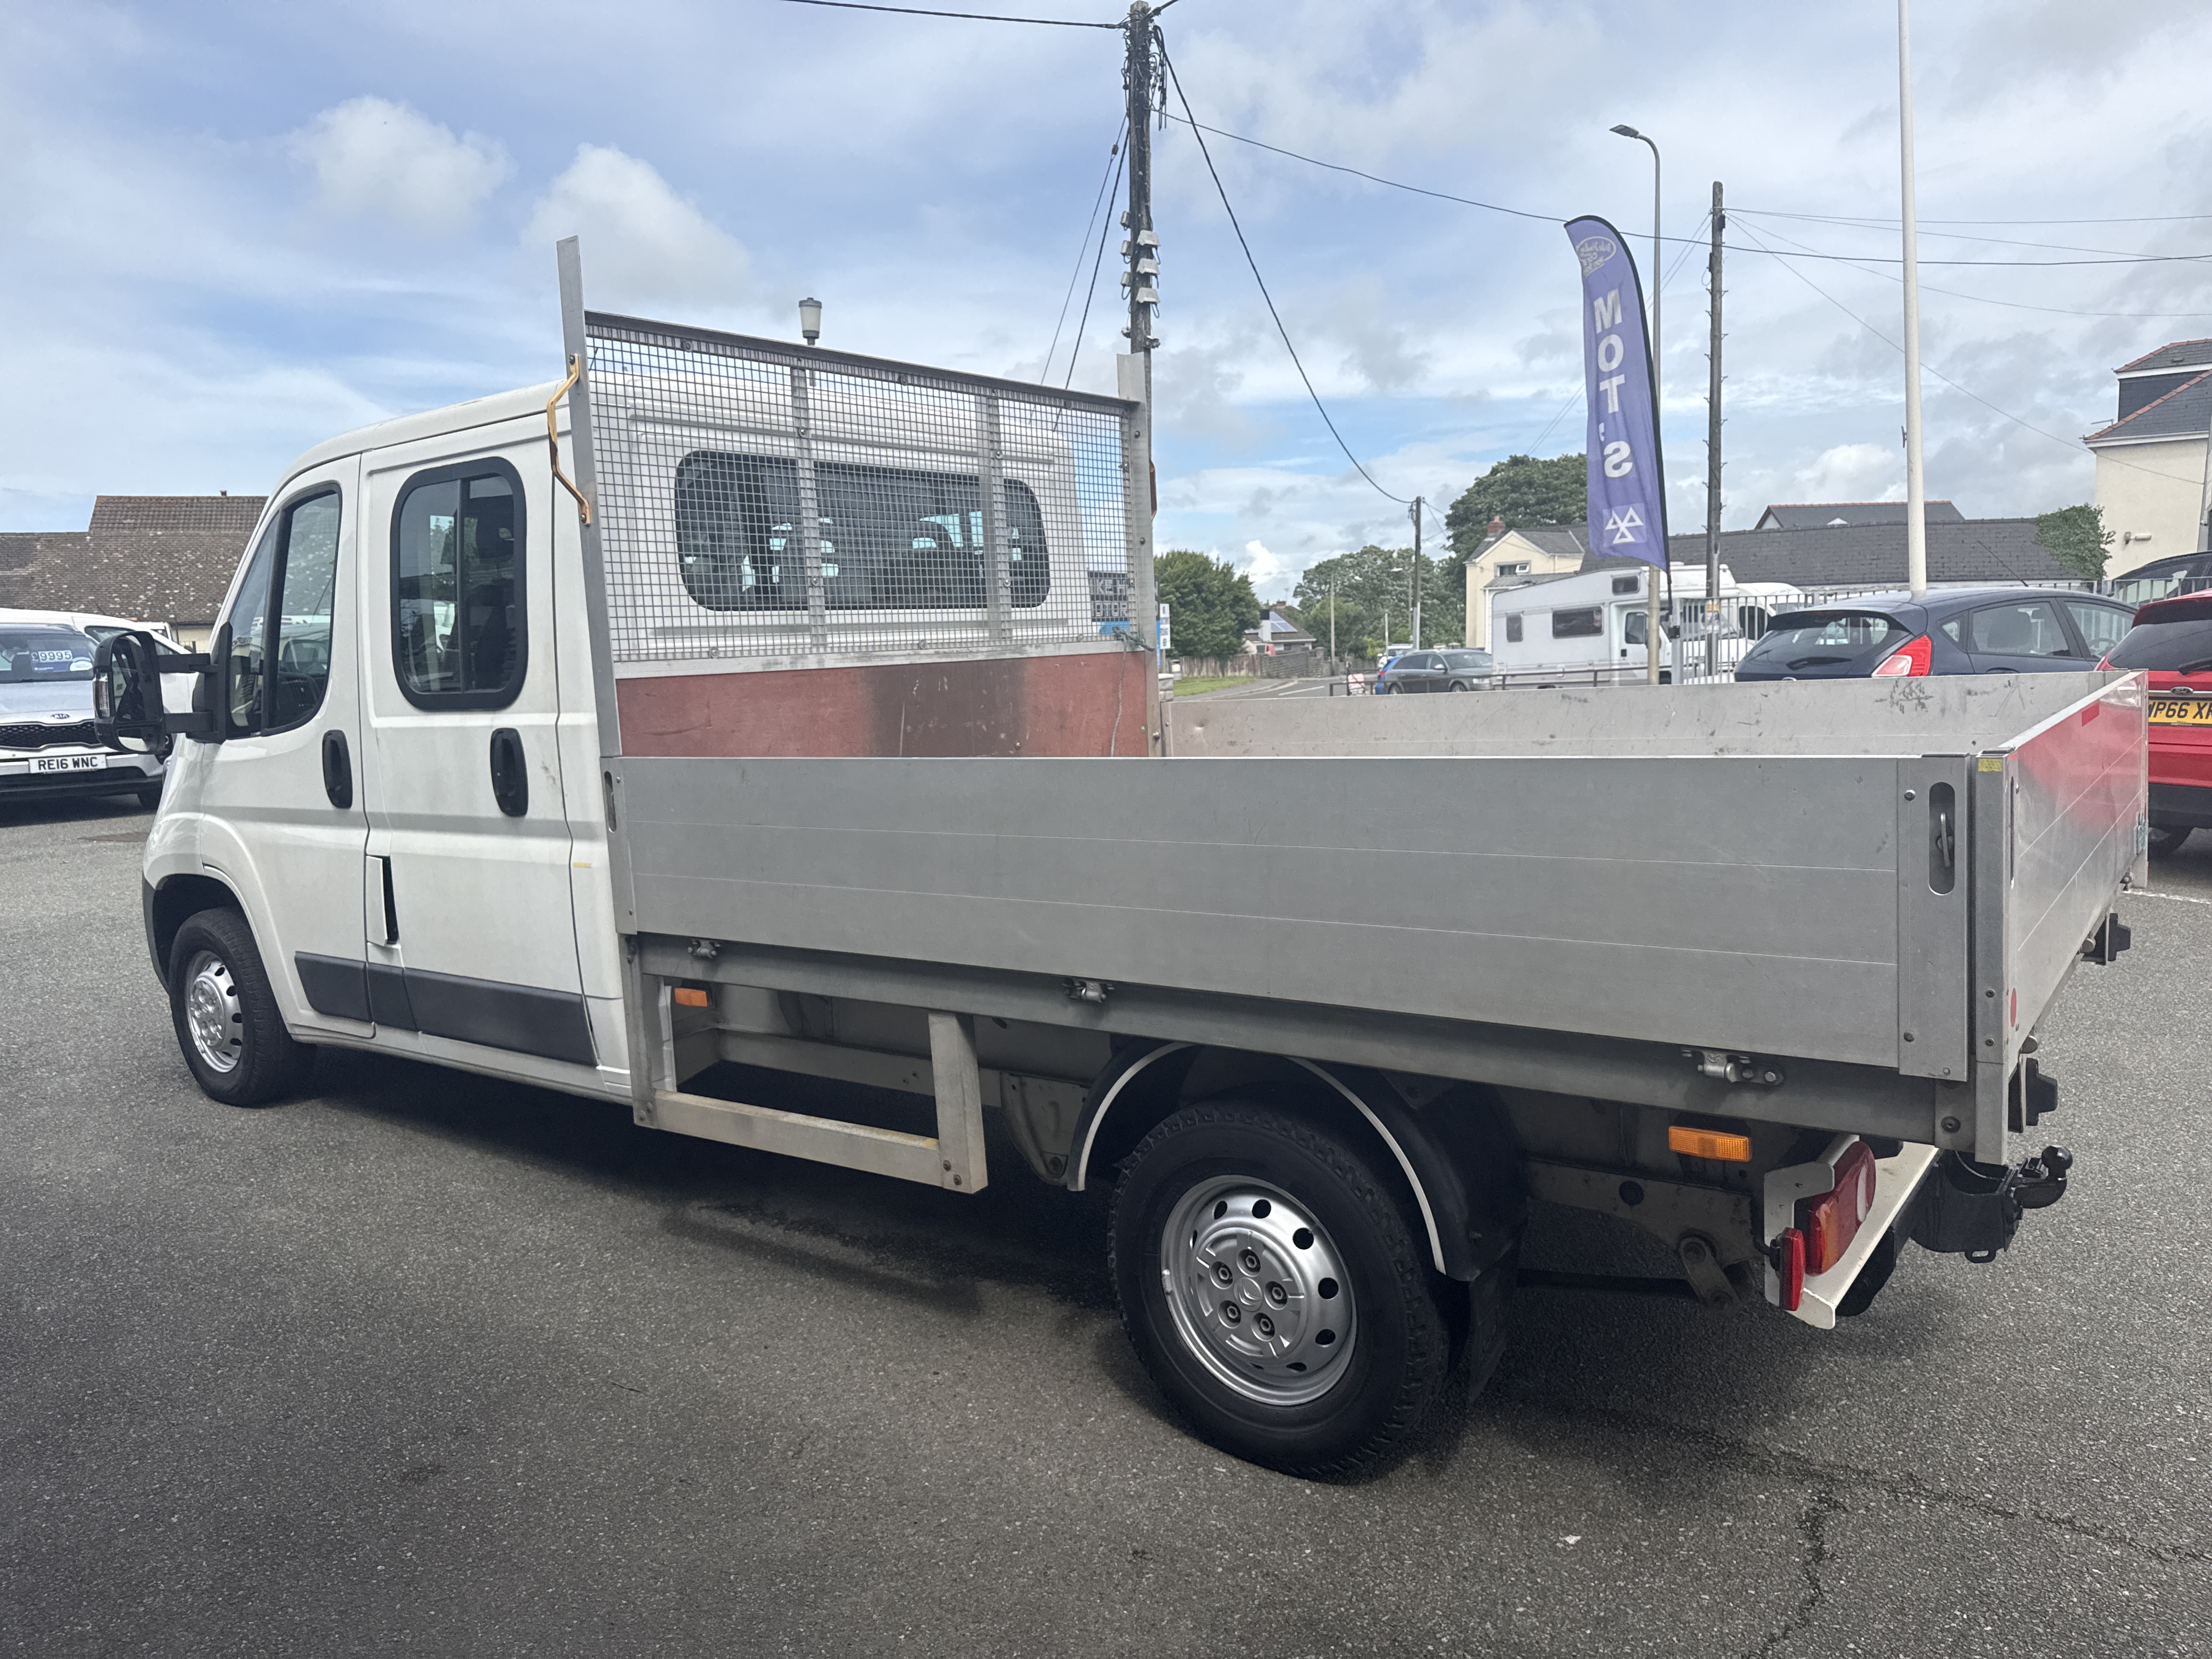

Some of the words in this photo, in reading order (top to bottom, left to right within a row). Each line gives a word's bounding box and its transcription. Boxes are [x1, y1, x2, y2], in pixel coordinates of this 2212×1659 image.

[1090, 579, 1114, 595] IKE
[38, 759, 69, 770] RE16
[72, 757, 98, 768] WNC
